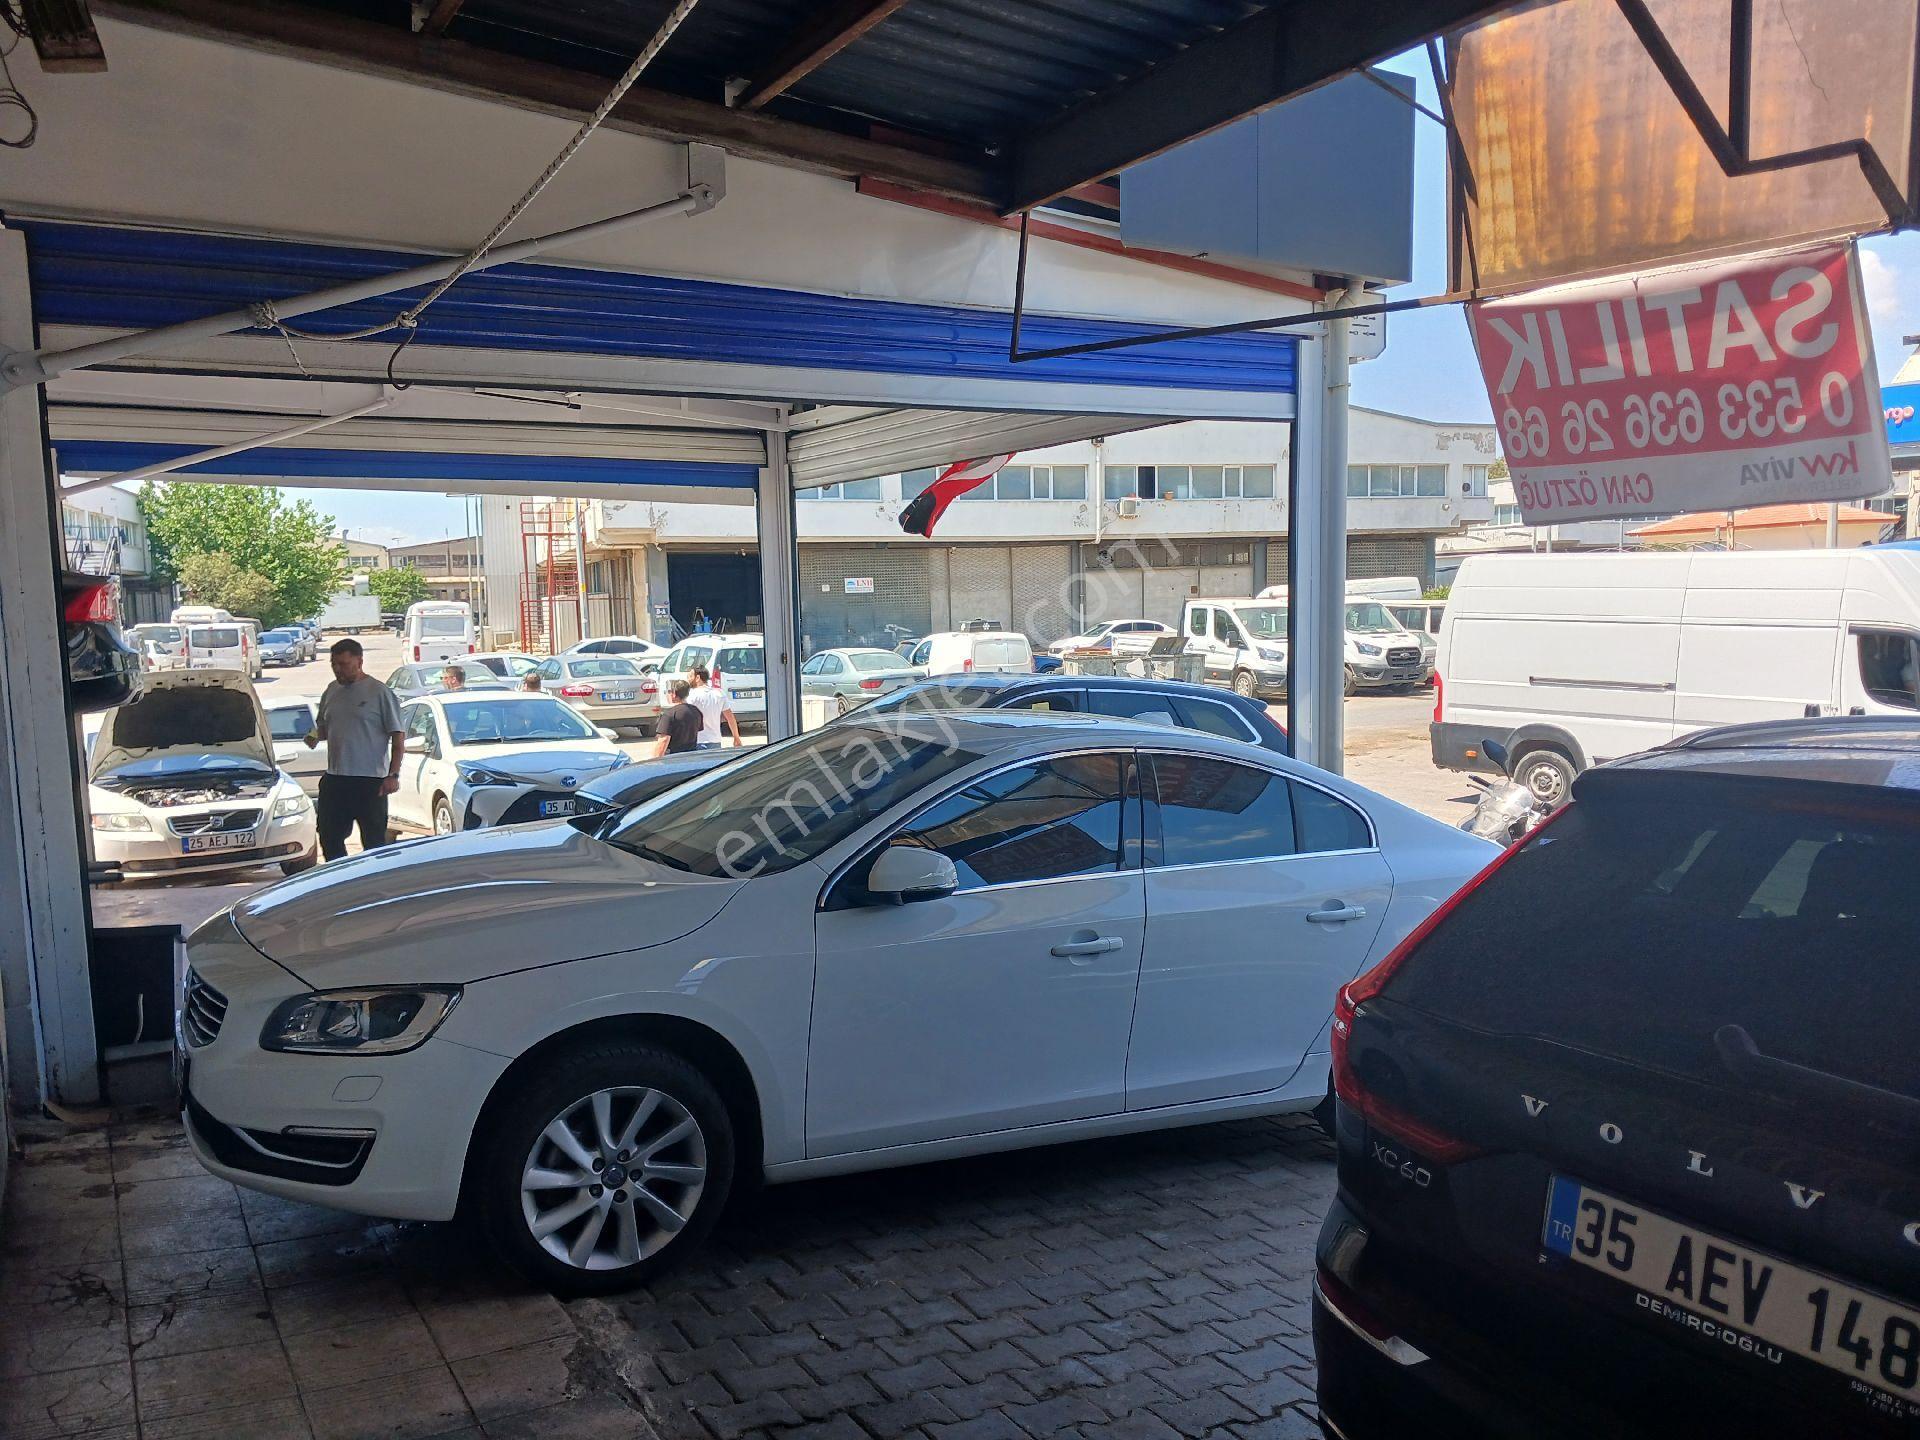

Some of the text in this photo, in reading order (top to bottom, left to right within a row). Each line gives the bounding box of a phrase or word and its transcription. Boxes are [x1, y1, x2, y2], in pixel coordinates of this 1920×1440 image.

[1884, 404, 1915, 425] rgo
[546, 801, 559, 813] 35
[235, 831, 253, 845] 122
[1371, 1140, 1431, 1188] XC60
[1552, 1198, 1920, 1389] TR 35 AEV 148
